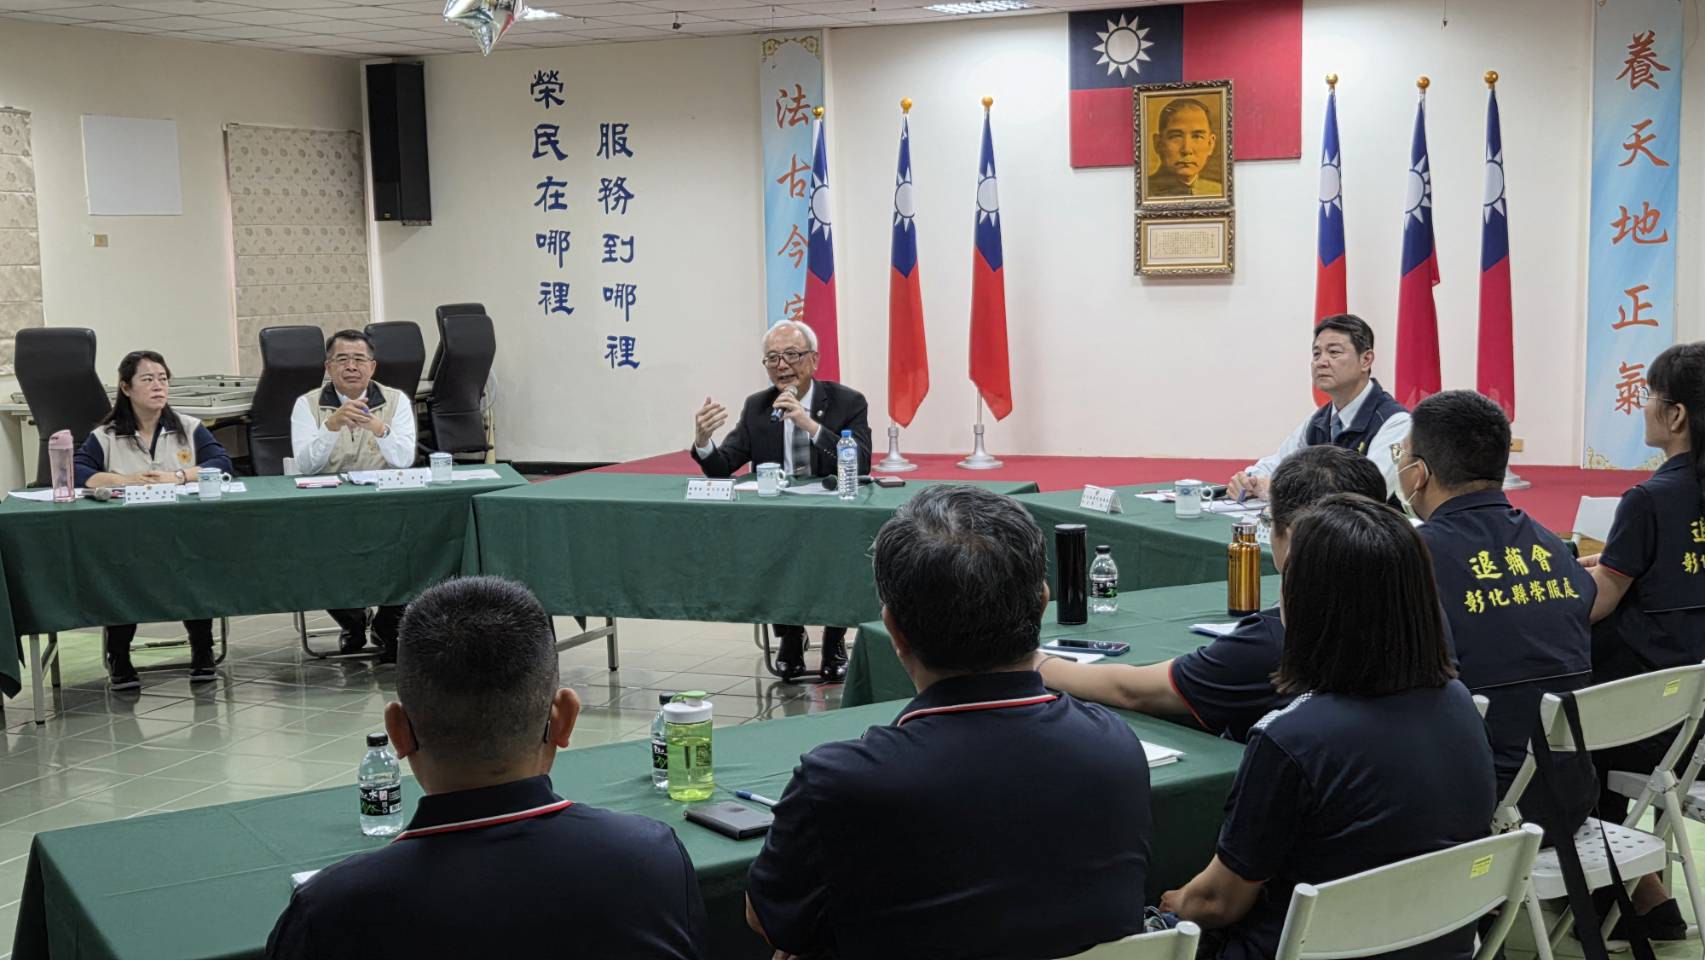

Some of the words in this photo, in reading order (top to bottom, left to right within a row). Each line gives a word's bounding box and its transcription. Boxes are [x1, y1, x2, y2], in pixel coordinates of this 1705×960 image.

[530, 69, 575, 316] 榮民在哪裡
[596, 122, 641, 370] 服務到哪裡
[1611, 30, 1671, 416] 養天地正氣
[1463, 576, 1581, 614] 彰化縣榮服處
[1468, 543, 1553, 580] 退輔會
[1681, 551, 1705, 574] 彰
